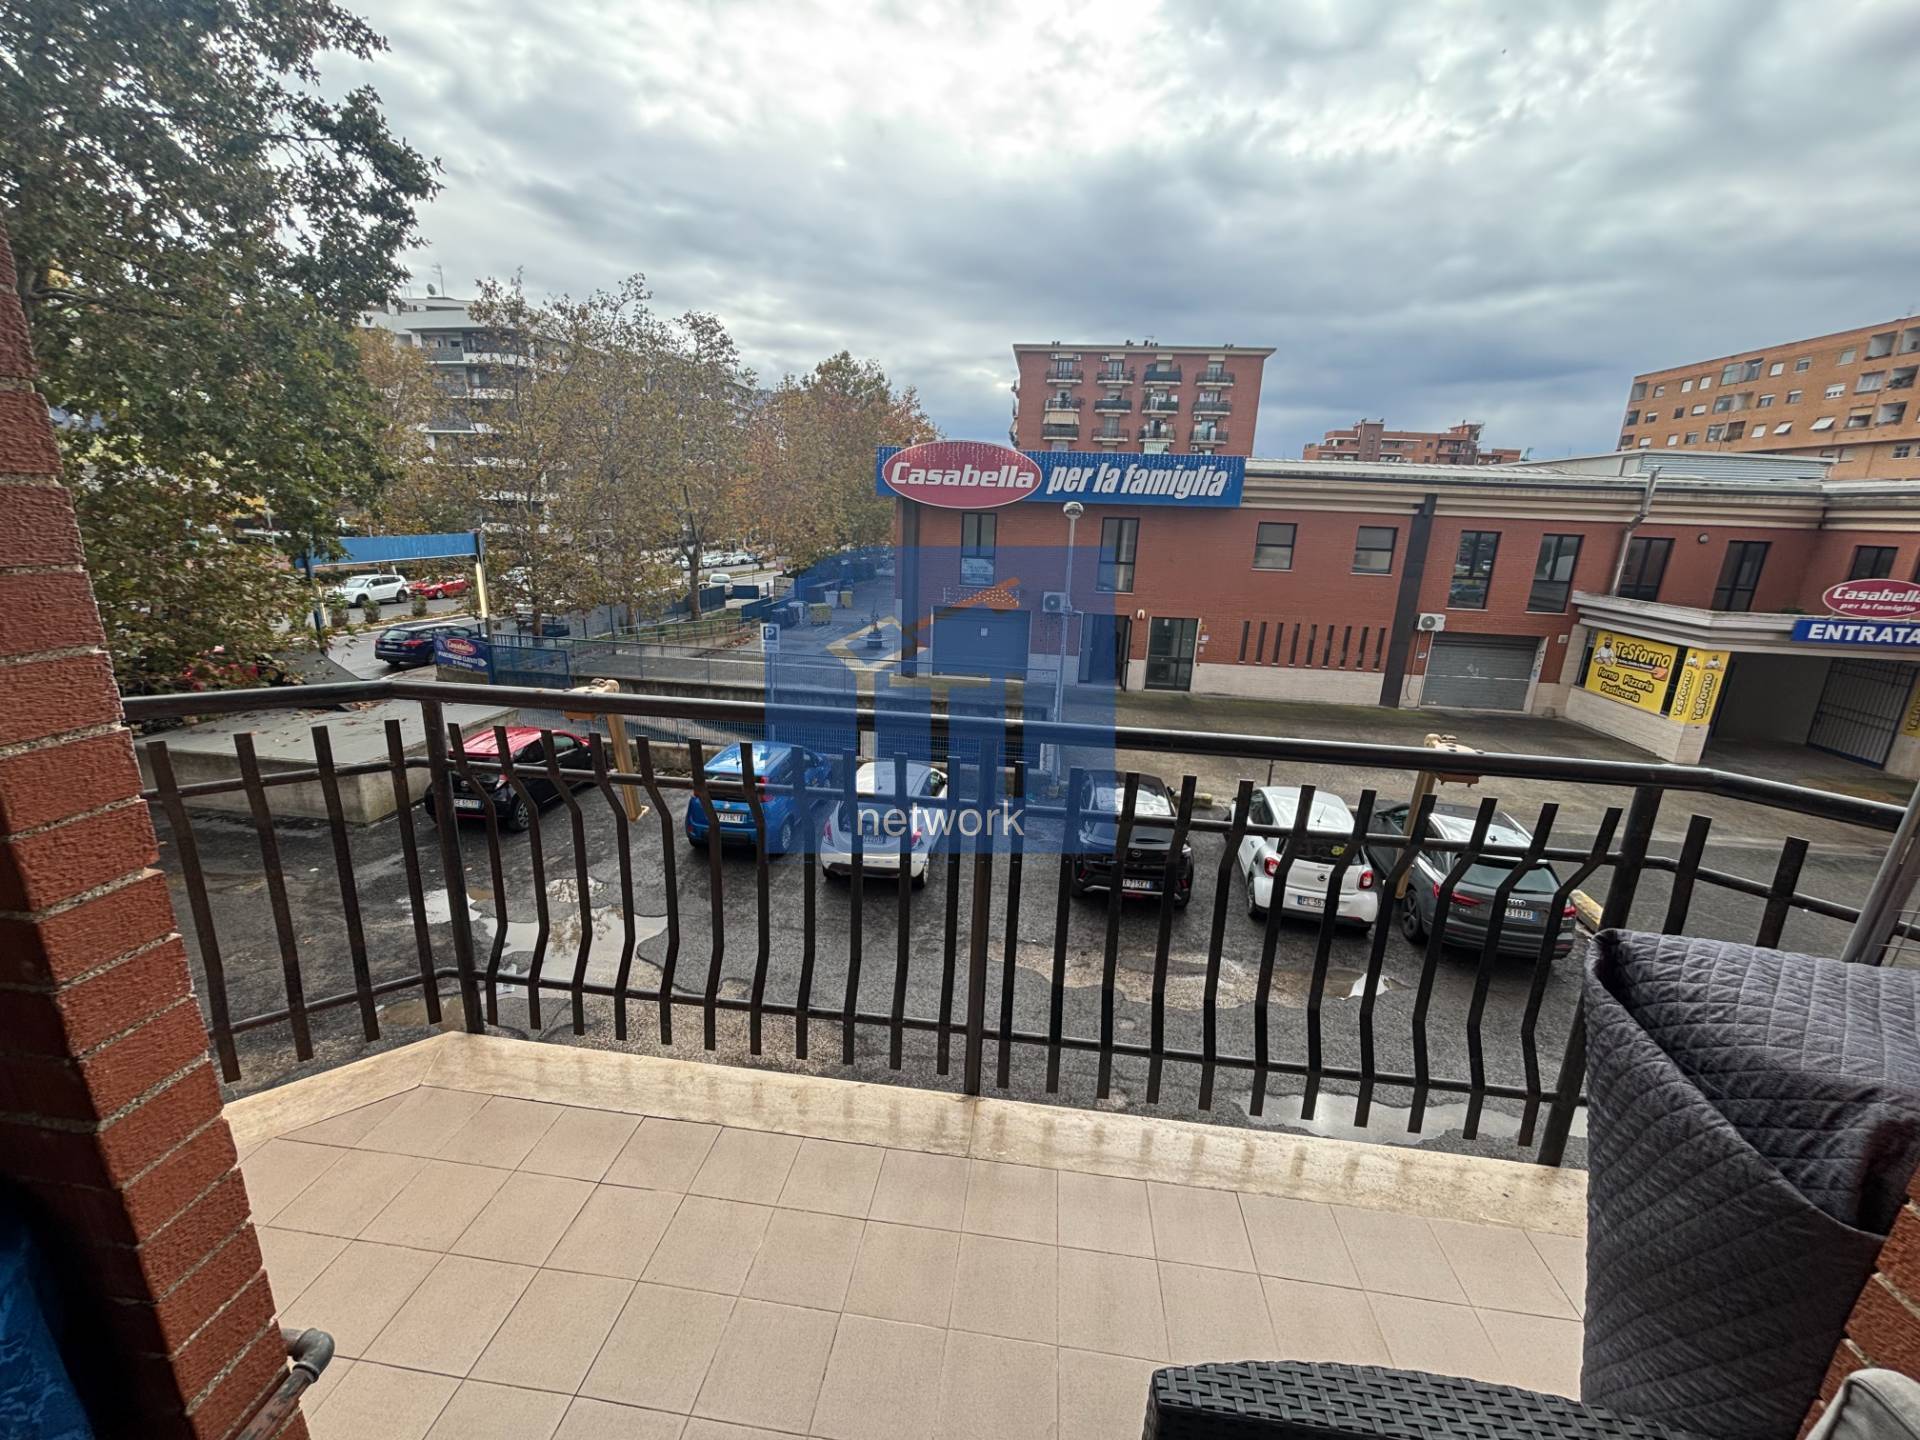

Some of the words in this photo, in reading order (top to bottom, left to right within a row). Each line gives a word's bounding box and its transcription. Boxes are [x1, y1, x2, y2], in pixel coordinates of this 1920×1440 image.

[890, 462, 1035, 489] Casabella
[1047, 465, 1092, 495] per
[1093, 462, 1117, 494] la
[1119, 463, 1229, 500] famiglia
[1839, 602, 1860, 610] per
[1871, 603, 1916, 613] famiglia
[765, 627, 775, 639] P
[1808, 623, 1920, 644] ENTRATA
